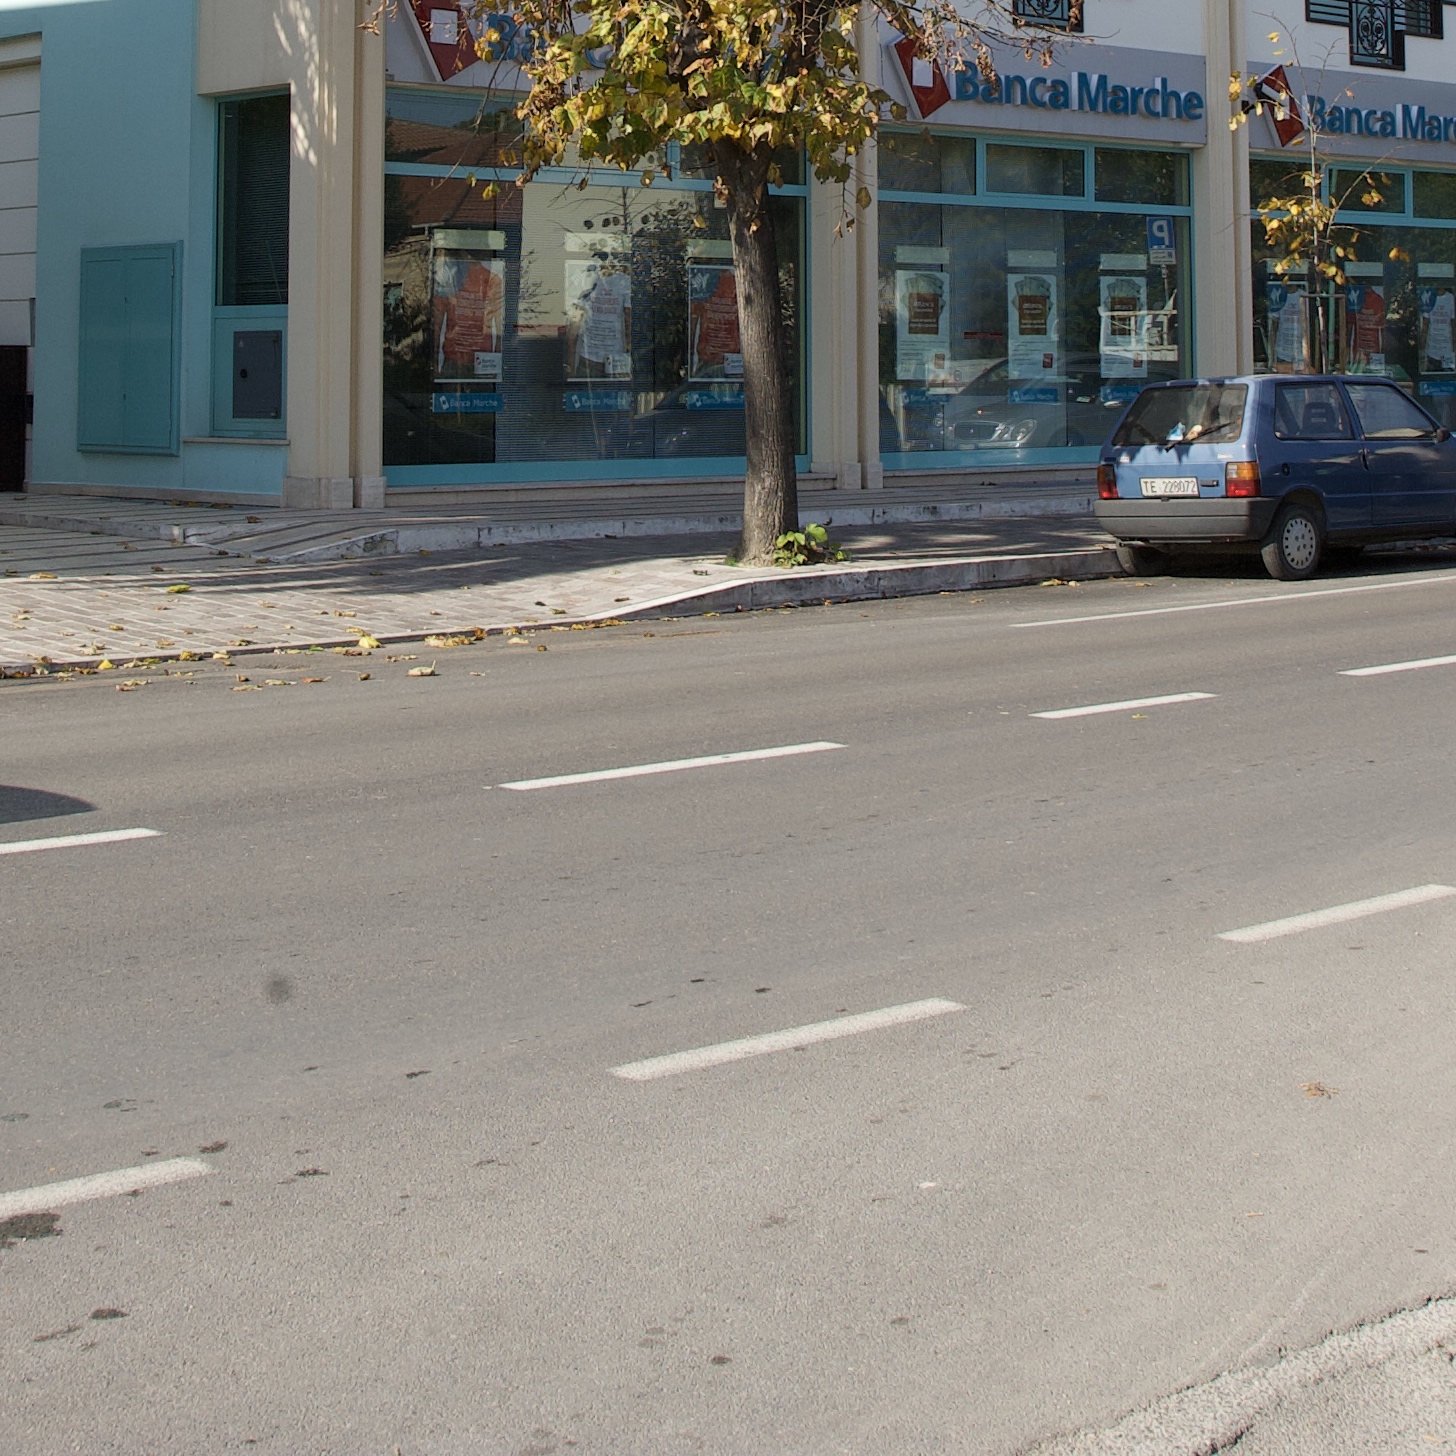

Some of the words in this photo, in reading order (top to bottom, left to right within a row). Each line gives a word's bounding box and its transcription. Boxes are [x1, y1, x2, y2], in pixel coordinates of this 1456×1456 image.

[953, 59, 1069, 109] Banca
[1074, 71, 1204, 120] Marche
[1305, 94, 1394, 137] Banca
[1141, 480, 1157, 494] TE
